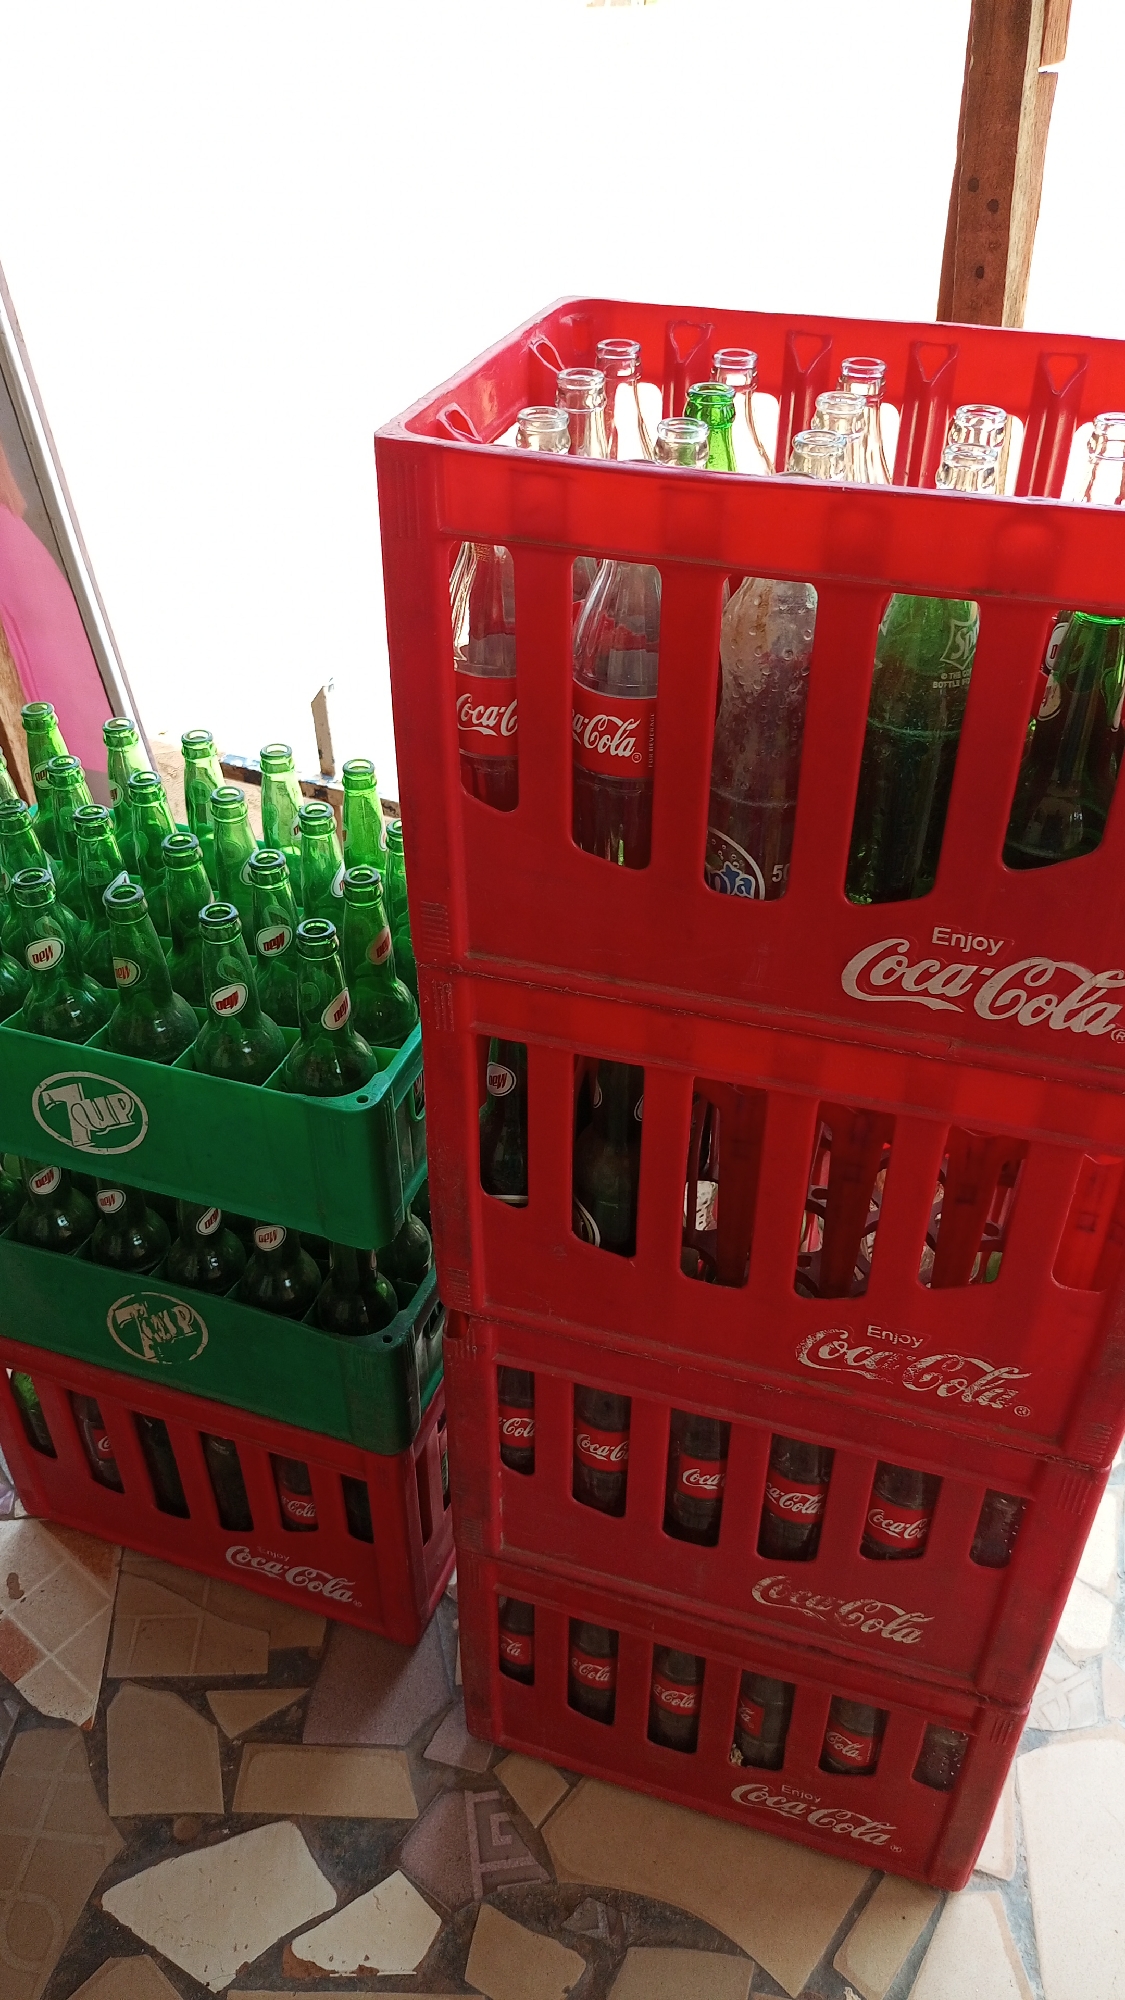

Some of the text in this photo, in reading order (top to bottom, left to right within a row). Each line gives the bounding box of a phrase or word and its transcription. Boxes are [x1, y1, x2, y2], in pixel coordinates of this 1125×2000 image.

[932, 680, 960, 689] BOTTLE
[931, 925, 1005, 956] Enjoy
[840, 937, 1125, 1036] Coca-Cola
[866, 1323, 925, 1349] Enjoy
[795, 1326, 1032, 1410] Coca-Cola
[225, 1545, 356, 1603] Coca-Cola
[751, 1574, 936, 1645] Coca-Cola
[730, 1783, 897, 1846] Coca-Cola
[780, 1784, 823, 1804] Enjoy
